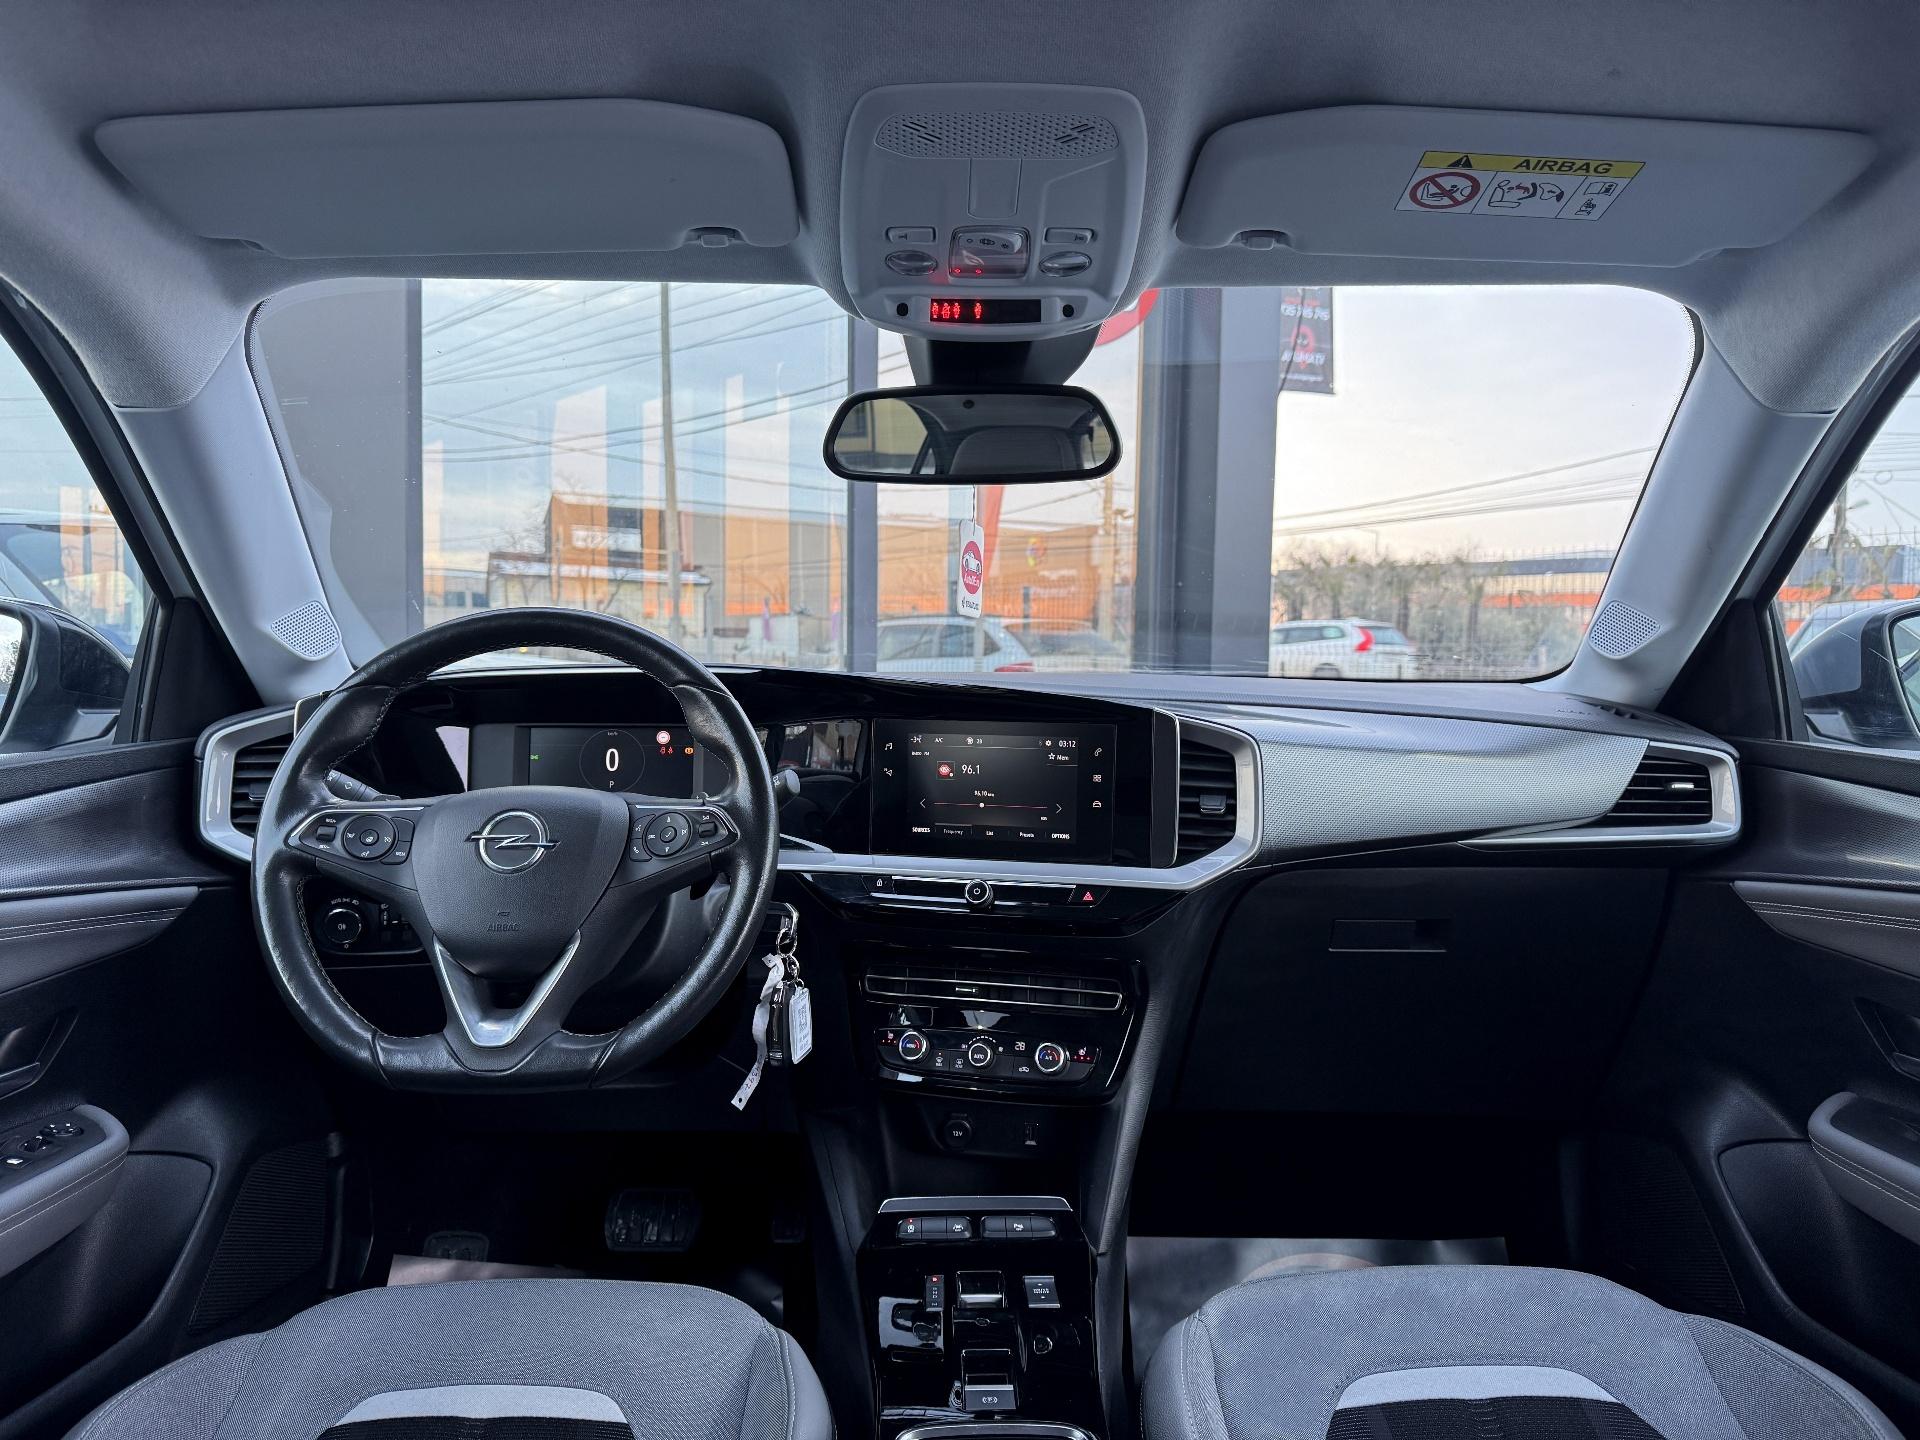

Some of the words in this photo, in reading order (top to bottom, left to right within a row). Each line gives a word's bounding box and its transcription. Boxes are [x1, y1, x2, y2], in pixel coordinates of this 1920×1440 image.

[1513, 159, 1613, 174] AIRBAG
[1058, 740, 1076, 748] 03:12
[605, 748, 619, 772] 0
[961, 765, 980, 775] 96.1
[609, 781, 615, 789] P
[1051, 832, 1070, 840] OPTIONS
[487, 922, 519, 932] AIRBAG
